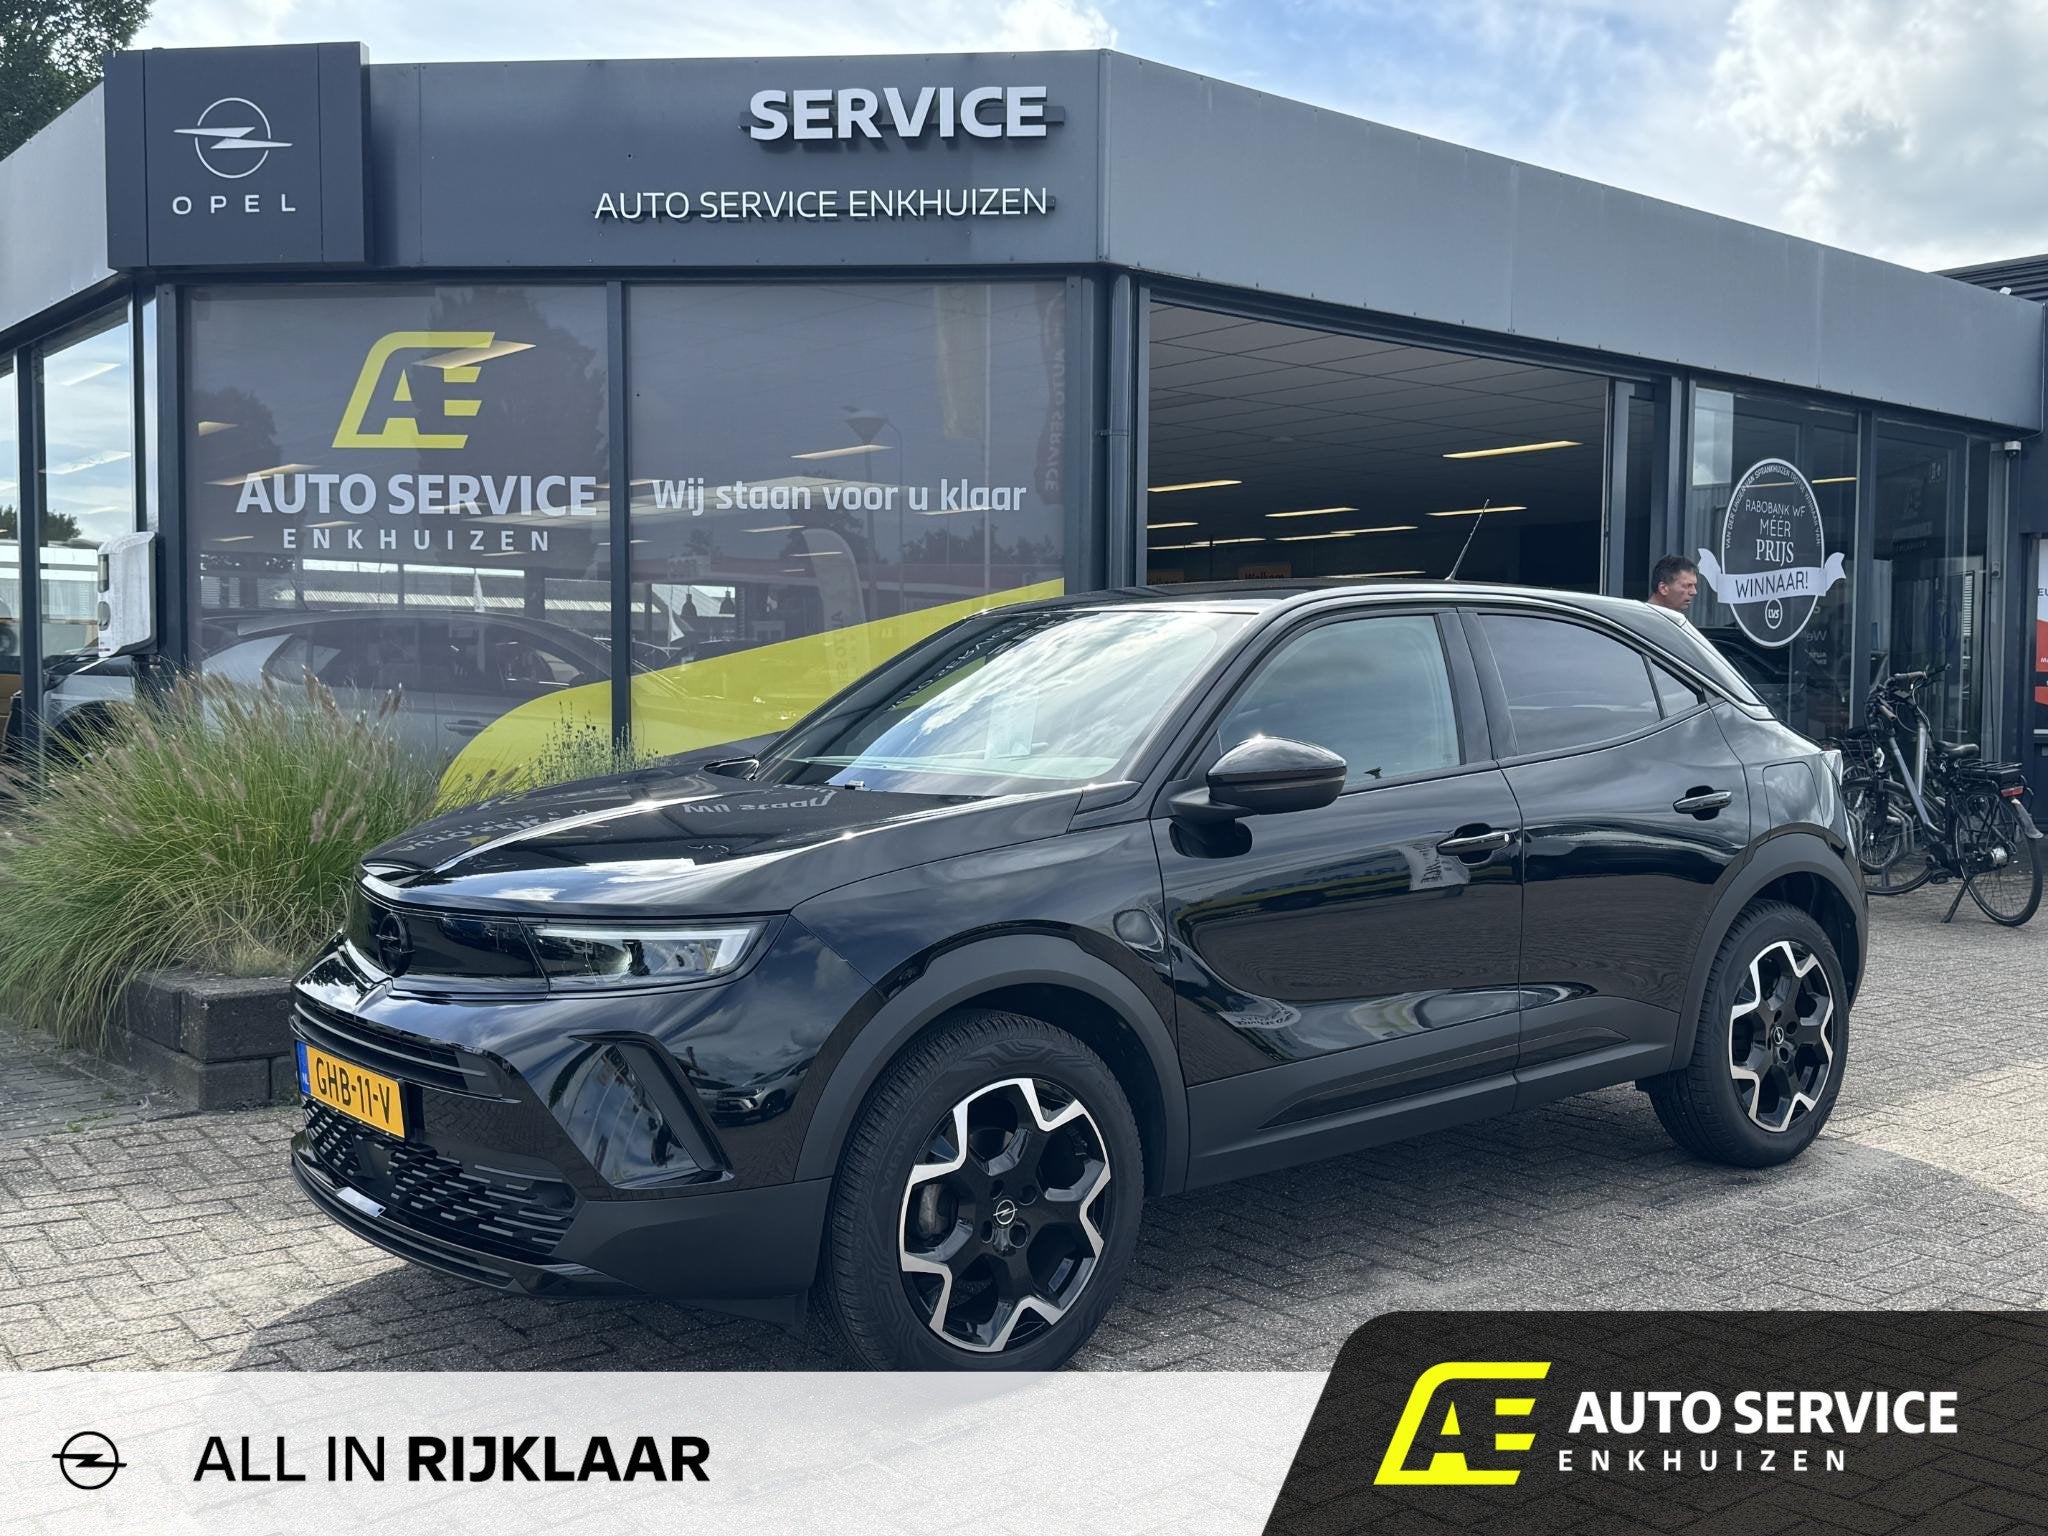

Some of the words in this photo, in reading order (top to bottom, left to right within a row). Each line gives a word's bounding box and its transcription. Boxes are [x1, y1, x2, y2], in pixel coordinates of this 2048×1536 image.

[750, 85, 1047, 140] SERVICE
[172, 193, 296, 215] OPEL
[594, 191, 690, 219] AUTO
[699, 190, 838, 218] SERVICE
[849, 187, 1047, 217] ENKHUIZEN
[236, 473, 377, 515] AUTO
[387, 474, 598, 516] SERVICE
[652, 478, 705, 517] Wij
[716, 481, 812, 511] staan
[823, 485, 899, 511] voor
[908, 486, 928, 511] u
[940, 478, 1027, 512] klaar
[1745, 499, 1790, 516] RABOBANK
[283, 528, 549, 552] ENKHUIZEN
[1759, 514, 1791, 538] MÉÉR
[1755, 538, 1794, 567] PRIJS
[1735, 571, 1808, 598] WINNAAR!
[316, 1057, 390, 1124] GHB-11-V
